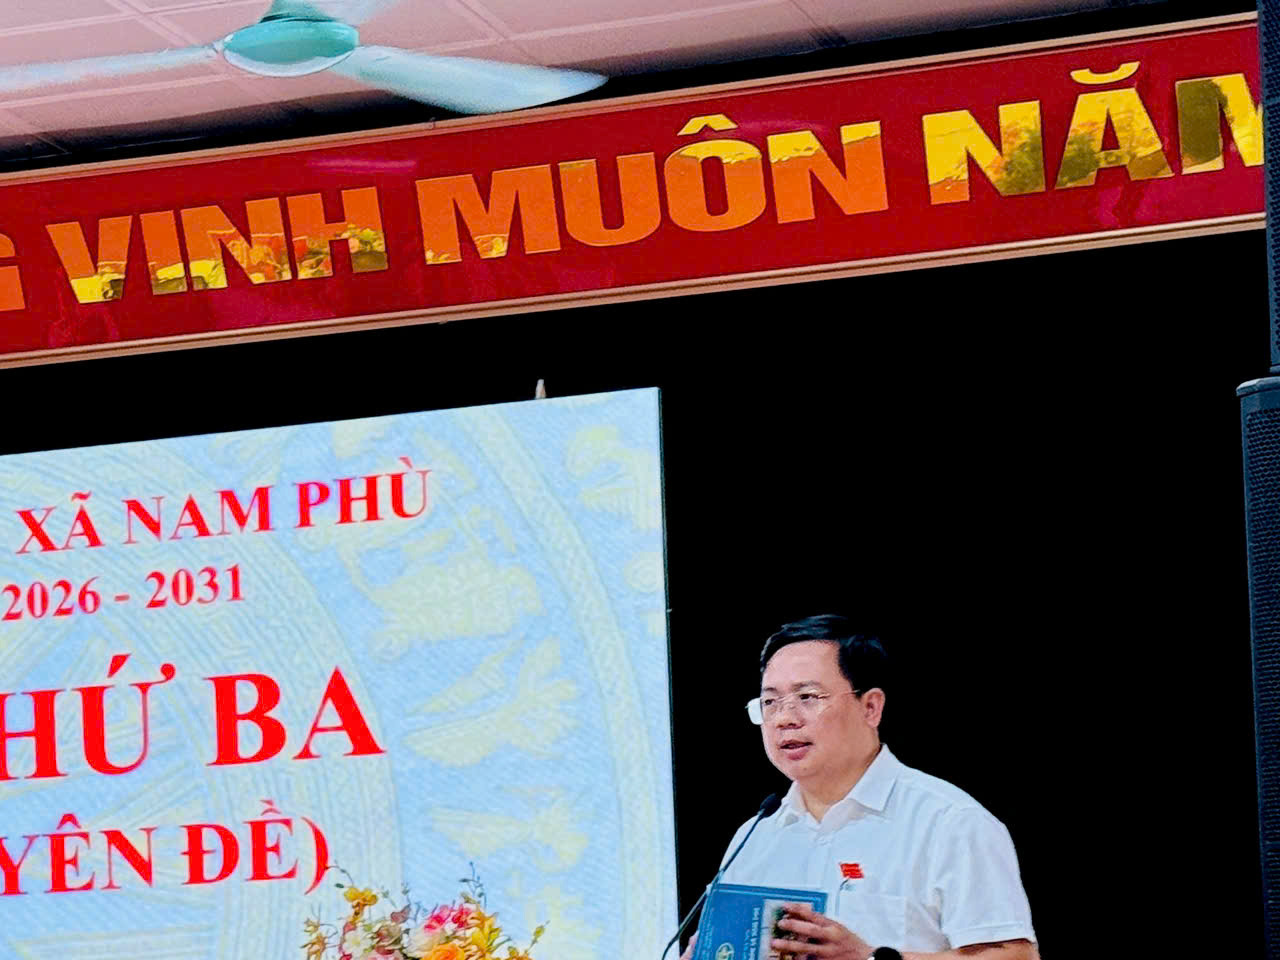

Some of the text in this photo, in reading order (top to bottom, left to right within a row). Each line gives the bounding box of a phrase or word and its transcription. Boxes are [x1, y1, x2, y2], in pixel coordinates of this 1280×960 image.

[46, 186, 390, 304] VINH
[414, 113, 890, 266] MUÔN
[17, 491, 103, 553] XÃ
[124, 485, 273, 539] NAM
[295, 456, 432, 529] PHÙ
[2, 579, 101, 622] 2026
[114, 594, 130, 602] -
[147, 564, 242, 609] 2031
[207, 667, 385, 767] BA
[181, 799, 330, 891] ĐỀ)
